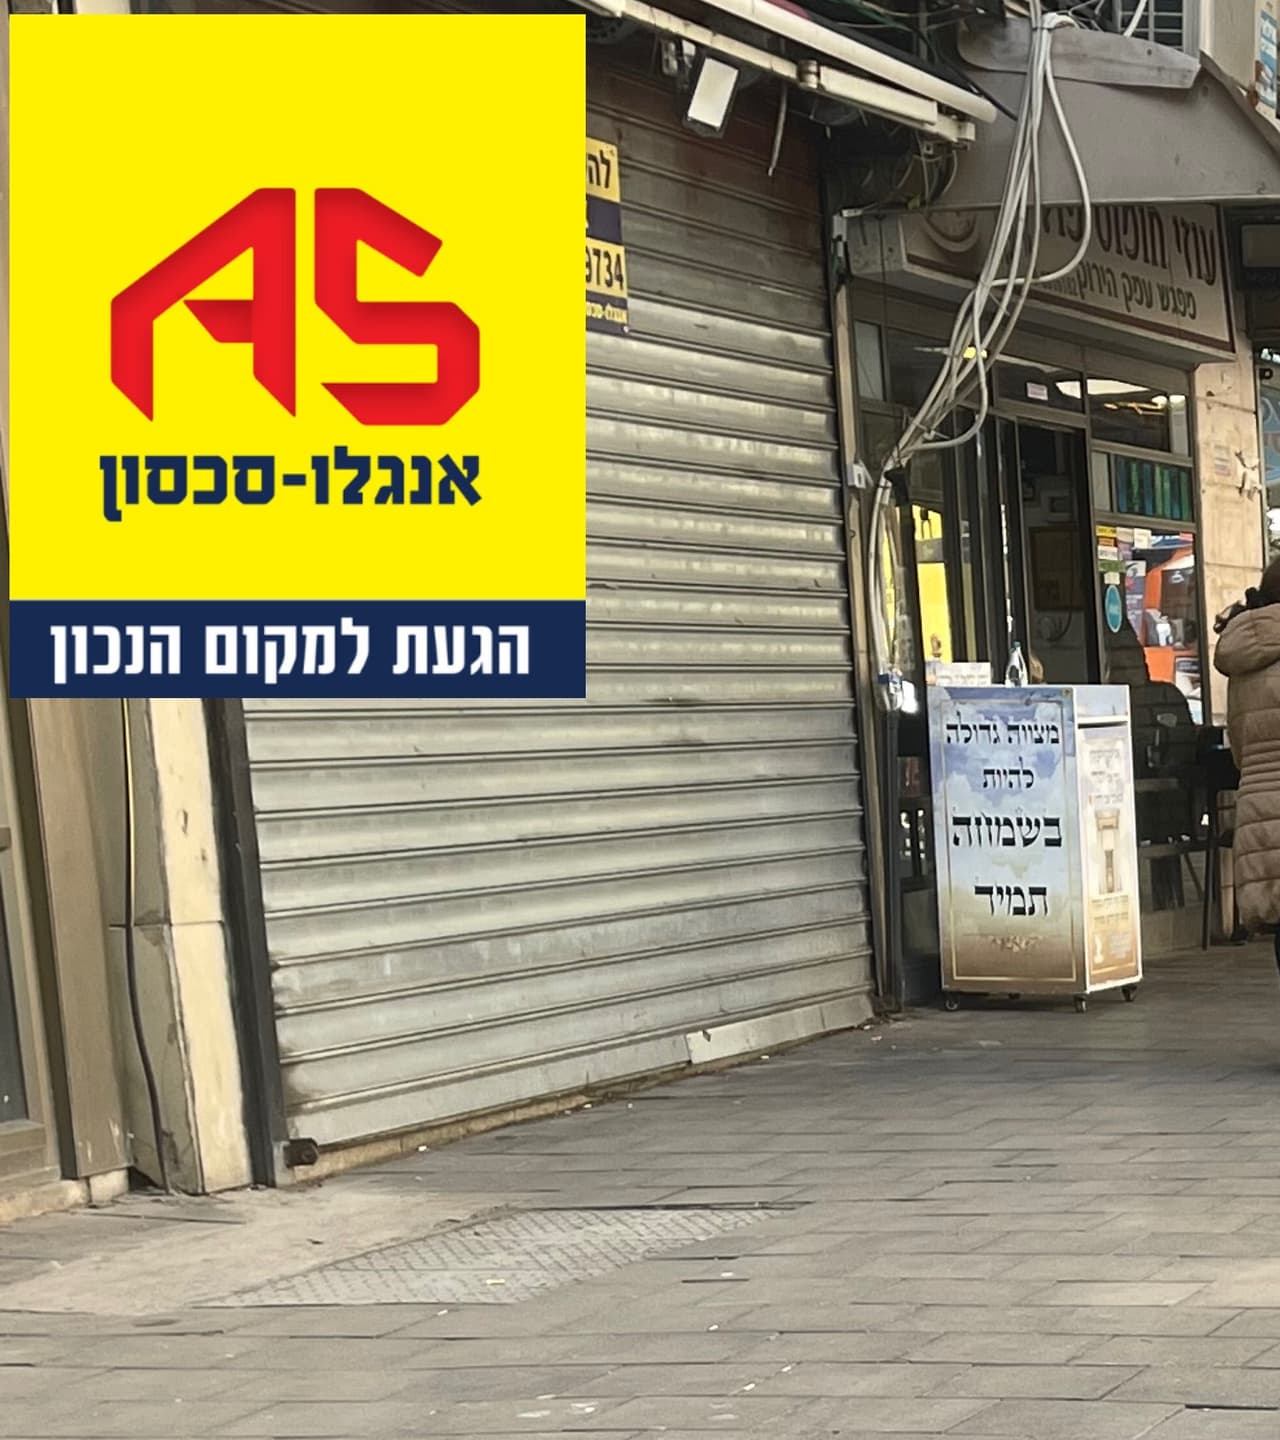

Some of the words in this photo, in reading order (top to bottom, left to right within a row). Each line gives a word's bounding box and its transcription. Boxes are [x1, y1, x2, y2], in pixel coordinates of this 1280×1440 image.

[586, 150, 610, 188] לה
[946, 709, 1001, 744] גדולה
[1007, 723, 1060, 744] מצווה
[983, 755, 1035, 789] להיות
[974, 884, 1048, 916] תמיד
